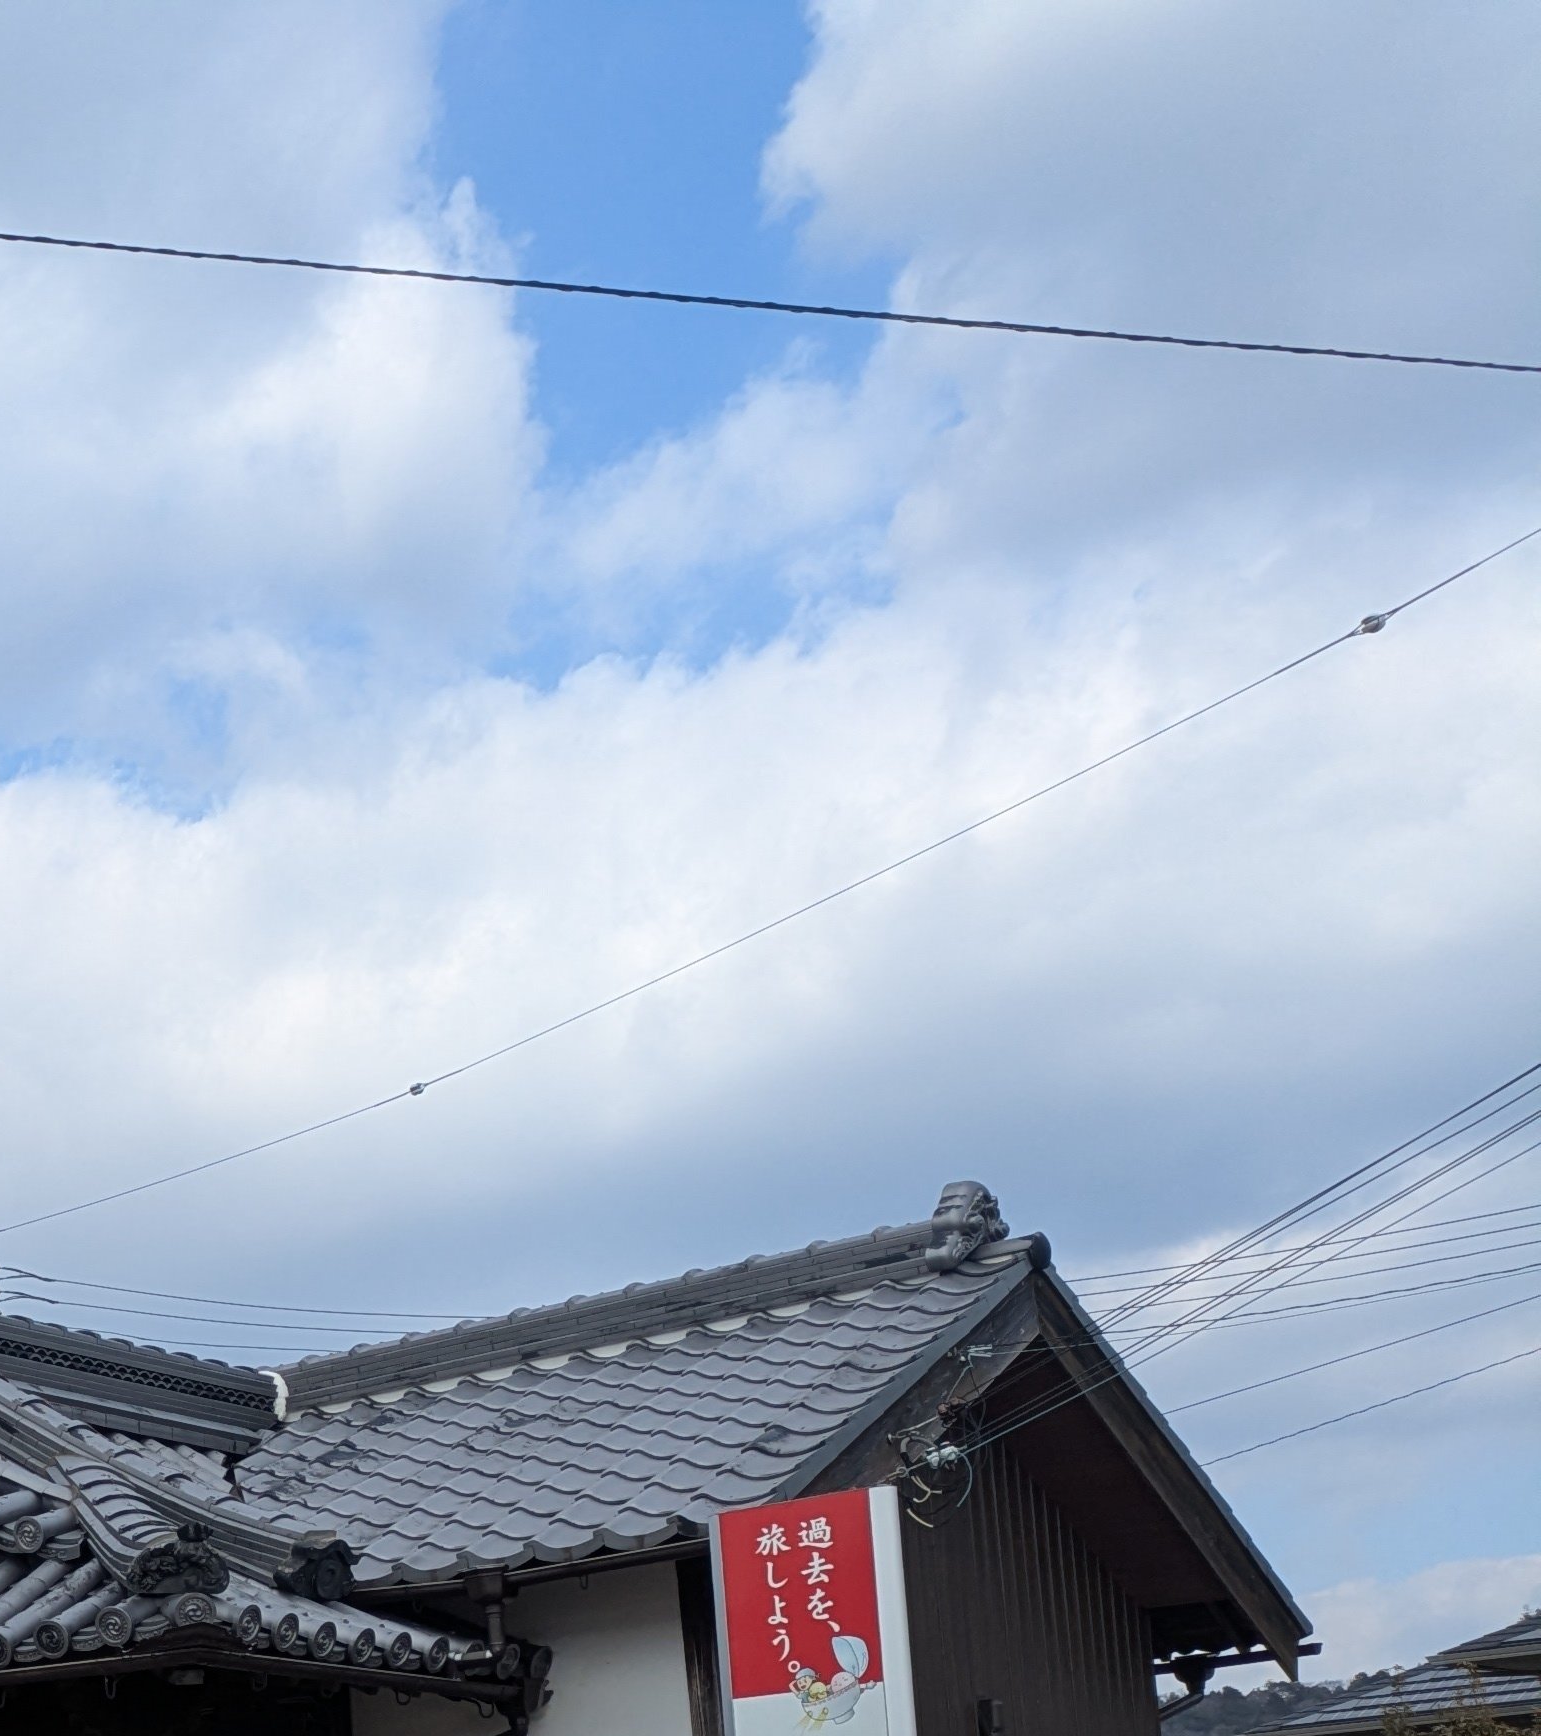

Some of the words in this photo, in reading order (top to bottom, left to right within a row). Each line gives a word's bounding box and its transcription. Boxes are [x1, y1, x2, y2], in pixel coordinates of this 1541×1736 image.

[755, 1524, 800, 1673] 旅しよう。
[798, 1517, 840, 1632] 過去を、
